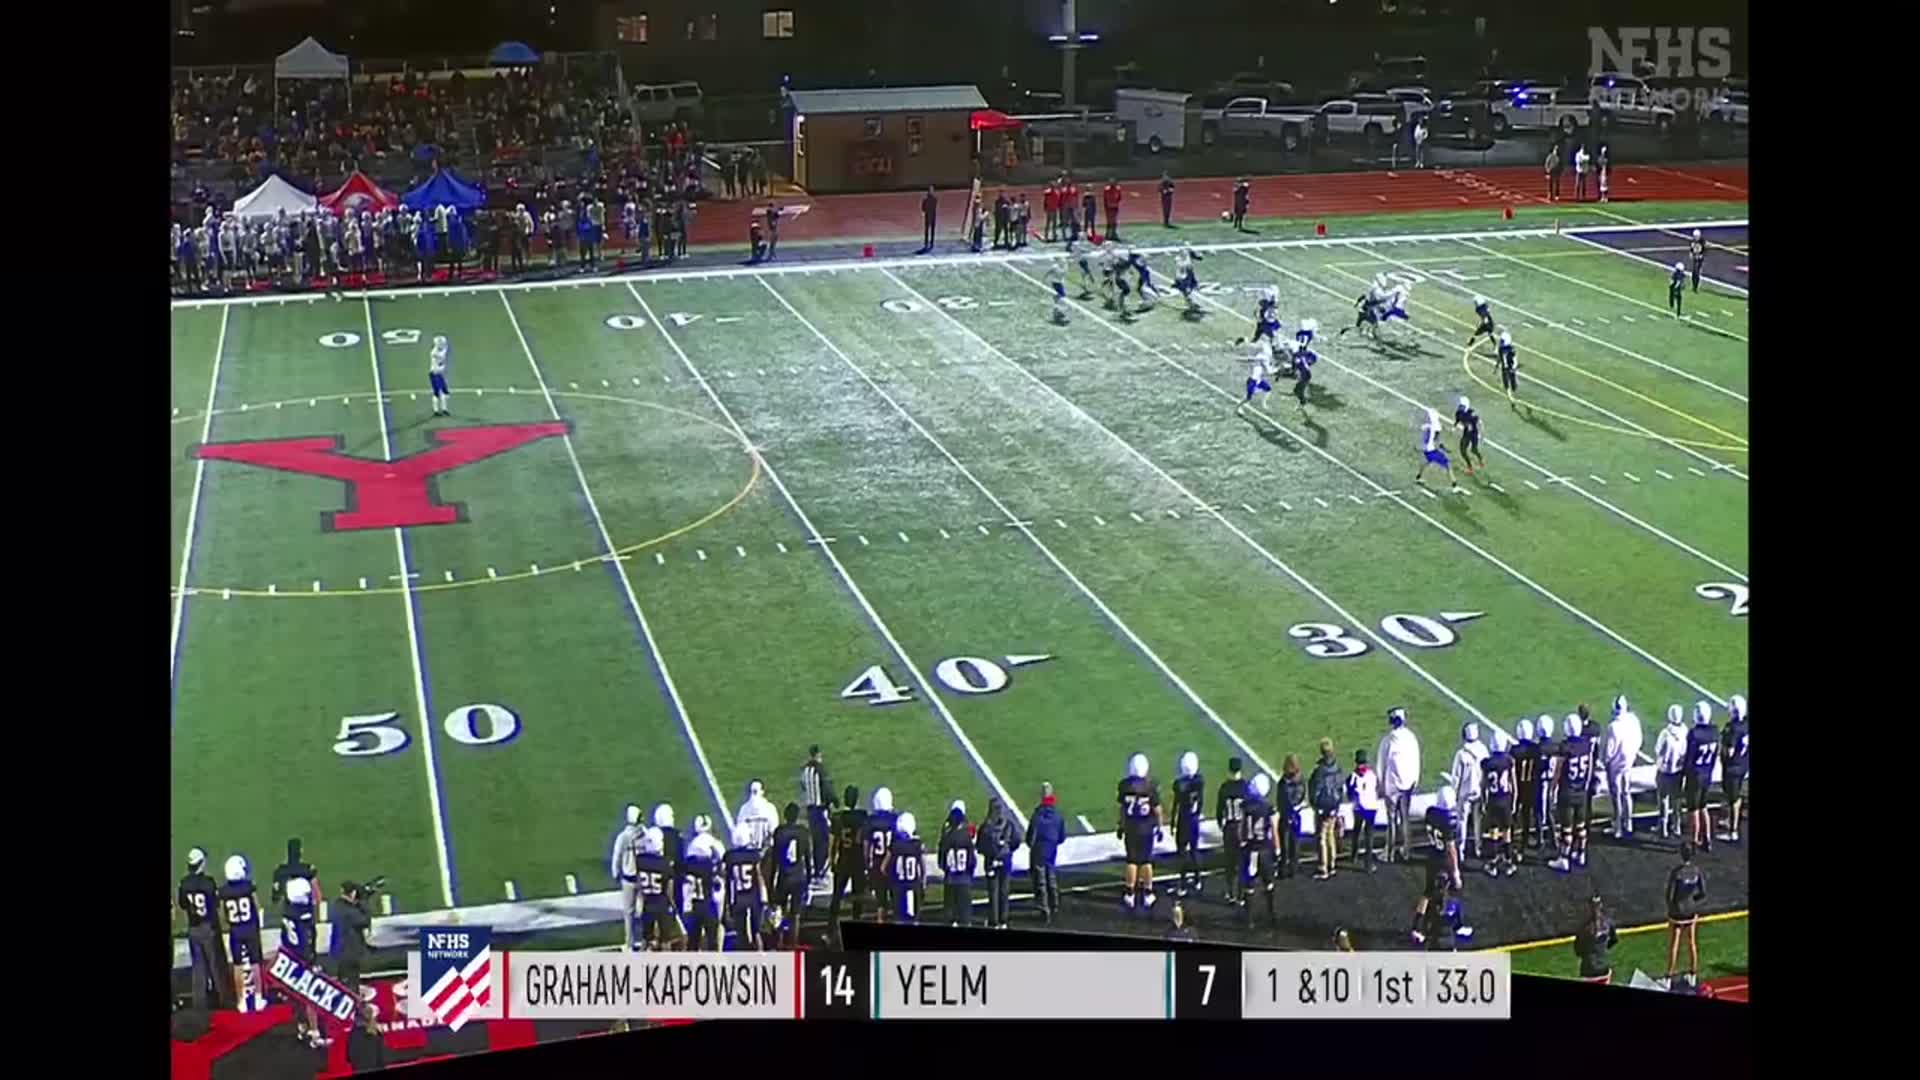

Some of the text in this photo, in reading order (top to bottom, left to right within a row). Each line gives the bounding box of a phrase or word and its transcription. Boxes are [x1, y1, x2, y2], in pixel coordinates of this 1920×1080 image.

[1288, 613, 1456, 658] 30
[841, 656, 1010, 704] 40
[333, 704, 521, 756] 50
[1488, 770, 1509, 793] 34
[1568, 755, 1589, 780] 55
[1125, 796, 1150, 816] 75
[226, 897, 251, 923] 29
[269, 952, 335, 1013] BLACK
